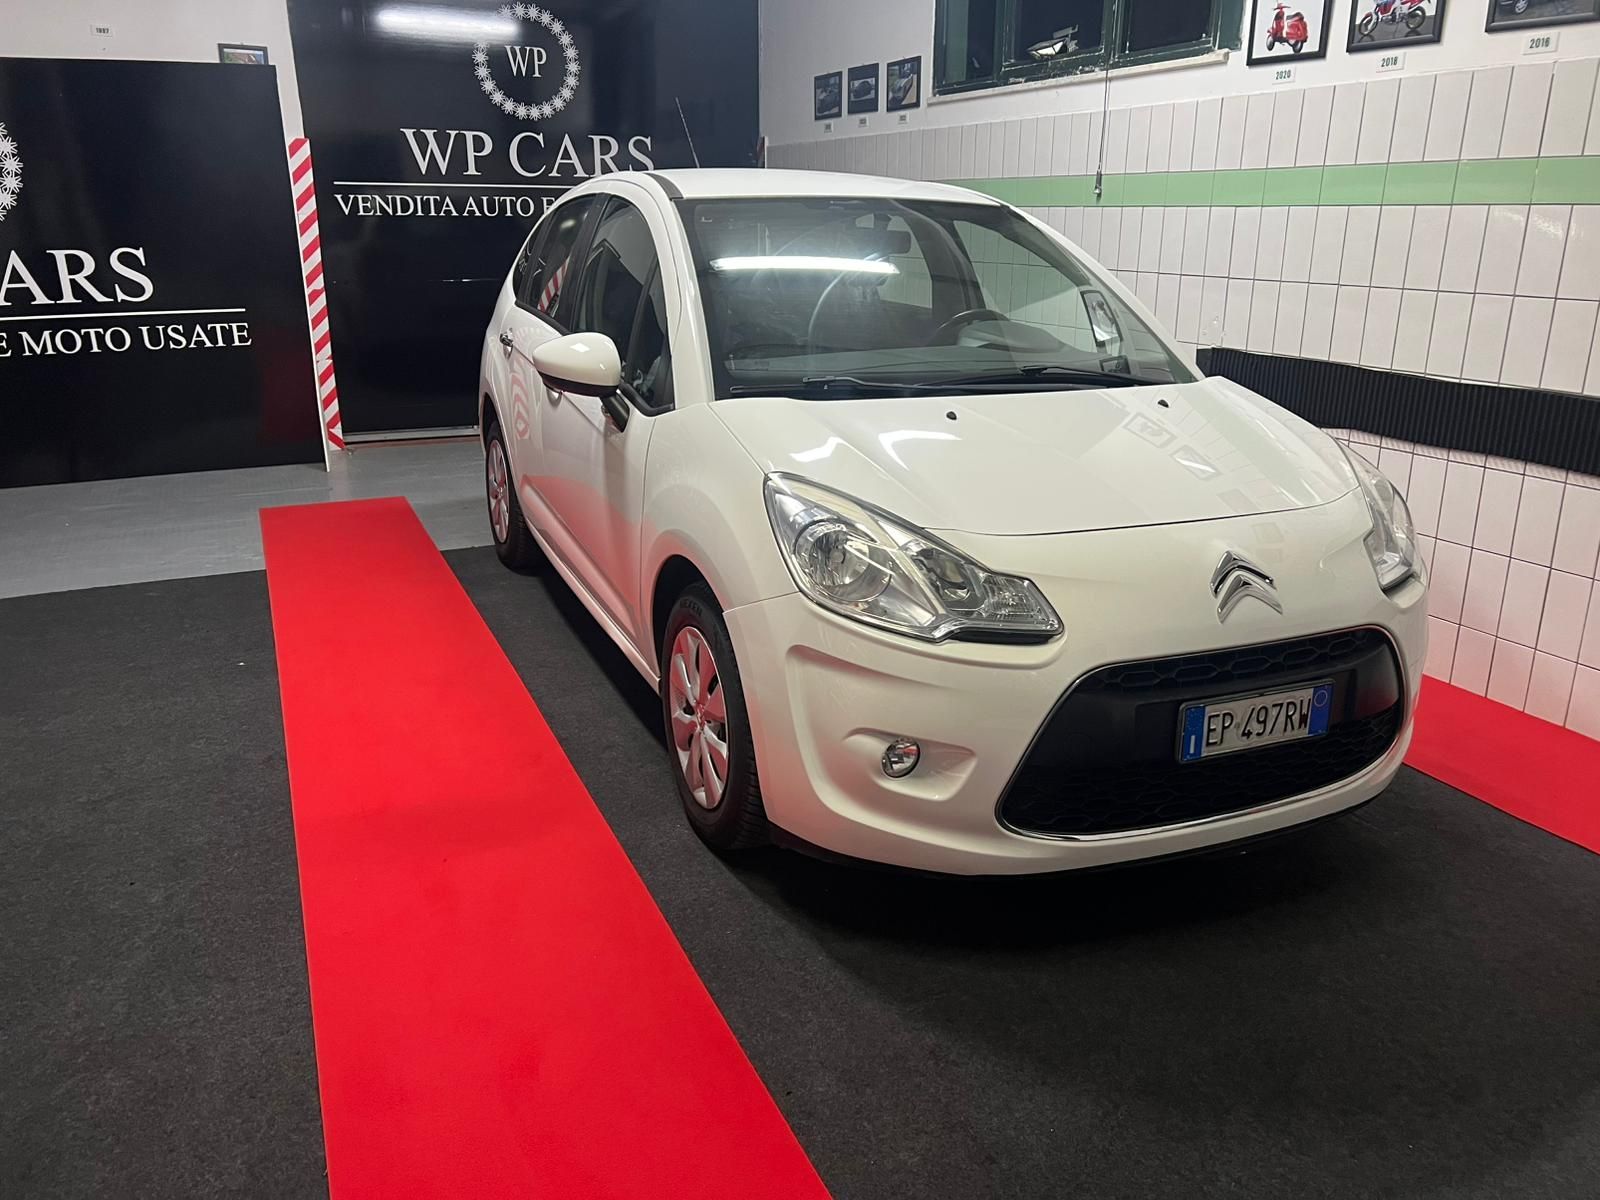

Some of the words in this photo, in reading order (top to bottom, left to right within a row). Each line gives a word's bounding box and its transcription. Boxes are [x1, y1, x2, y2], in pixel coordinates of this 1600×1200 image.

[1529, 36, 1551, 49] 2016
[504, 45, 547, 77] WP
[400, 128, 493, 176] WP
[508, 132, 655, 178] CARS
[334, 194, 457, 216] VENDITA
[462, 196, 535, 217] AUTO
[18, 327, 131, 356] MOTO
[138, 322, 252, 350] USATE
[1206, 711, 1234, 747] EP
[1241, 698, 1311, 738] 497RW
